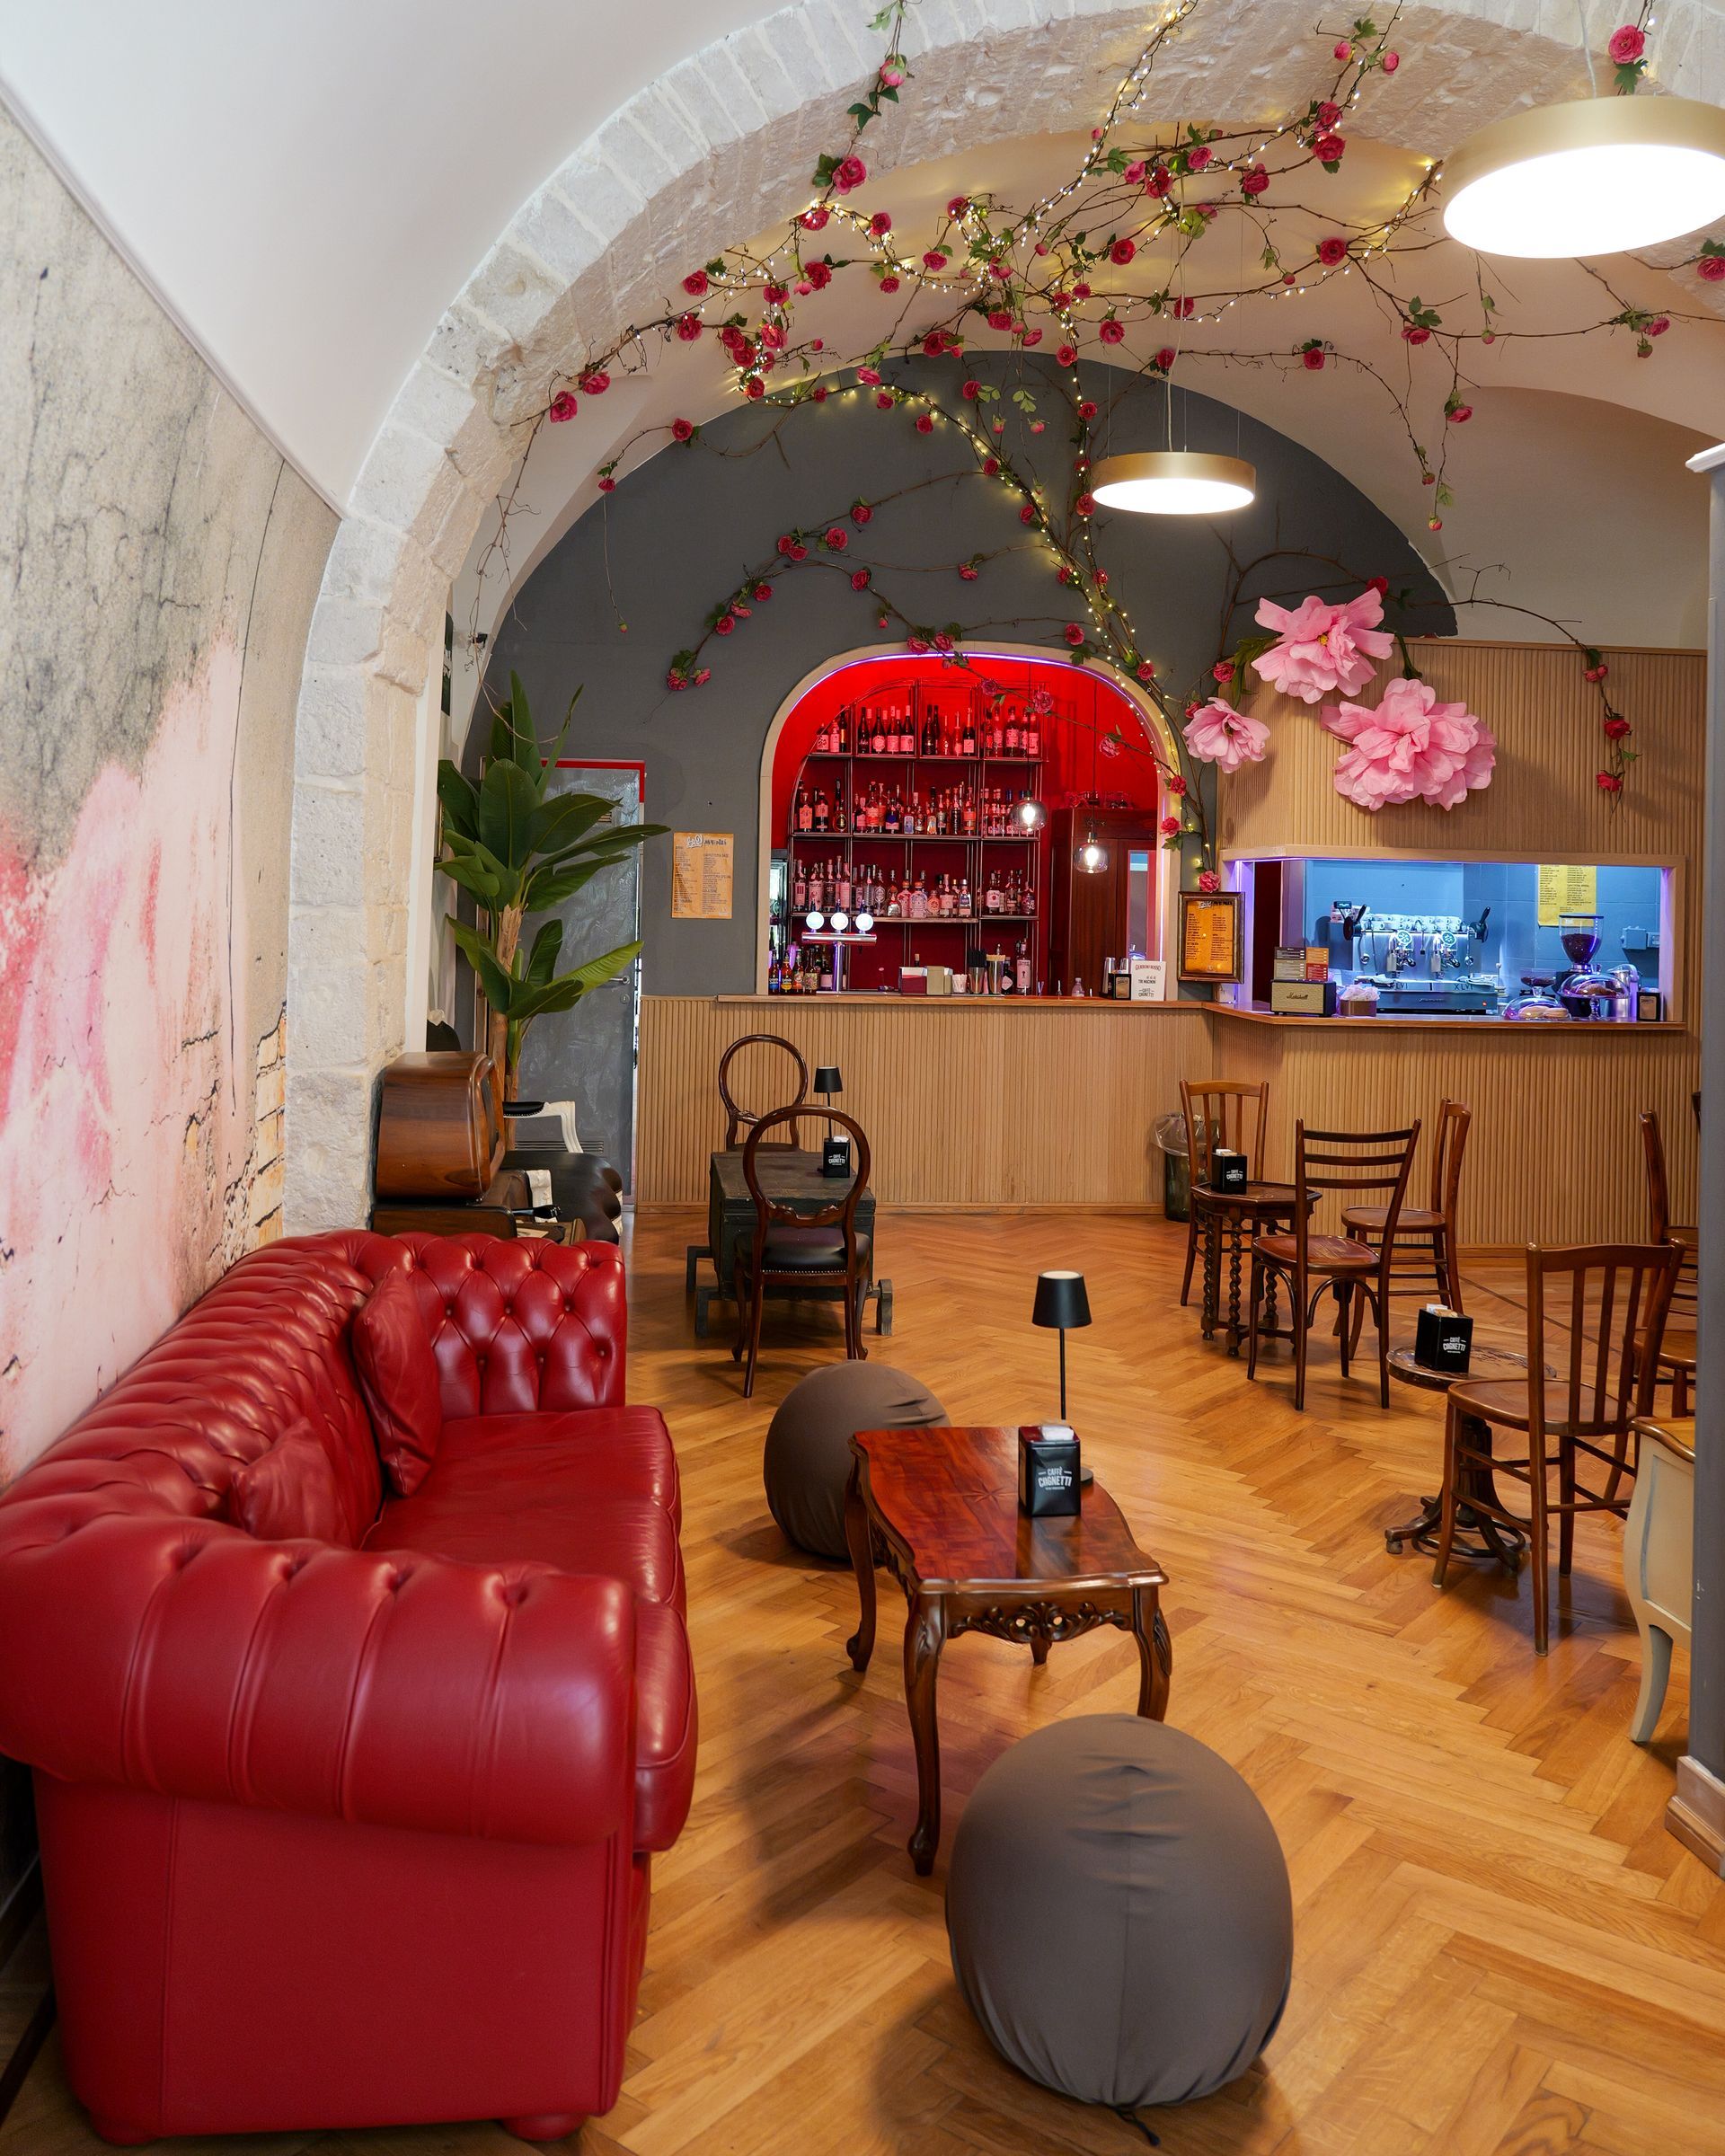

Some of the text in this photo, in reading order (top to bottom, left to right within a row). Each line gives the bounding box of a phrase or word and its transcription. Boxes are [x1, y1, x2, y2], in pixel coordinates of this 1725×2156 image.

[1443, 1342, 1466, 1351] COGNETTI
[1047, 1466, 1063, 1475] CAFFÈ
[1038, 1476, 1073, 1488] COGNETTI
